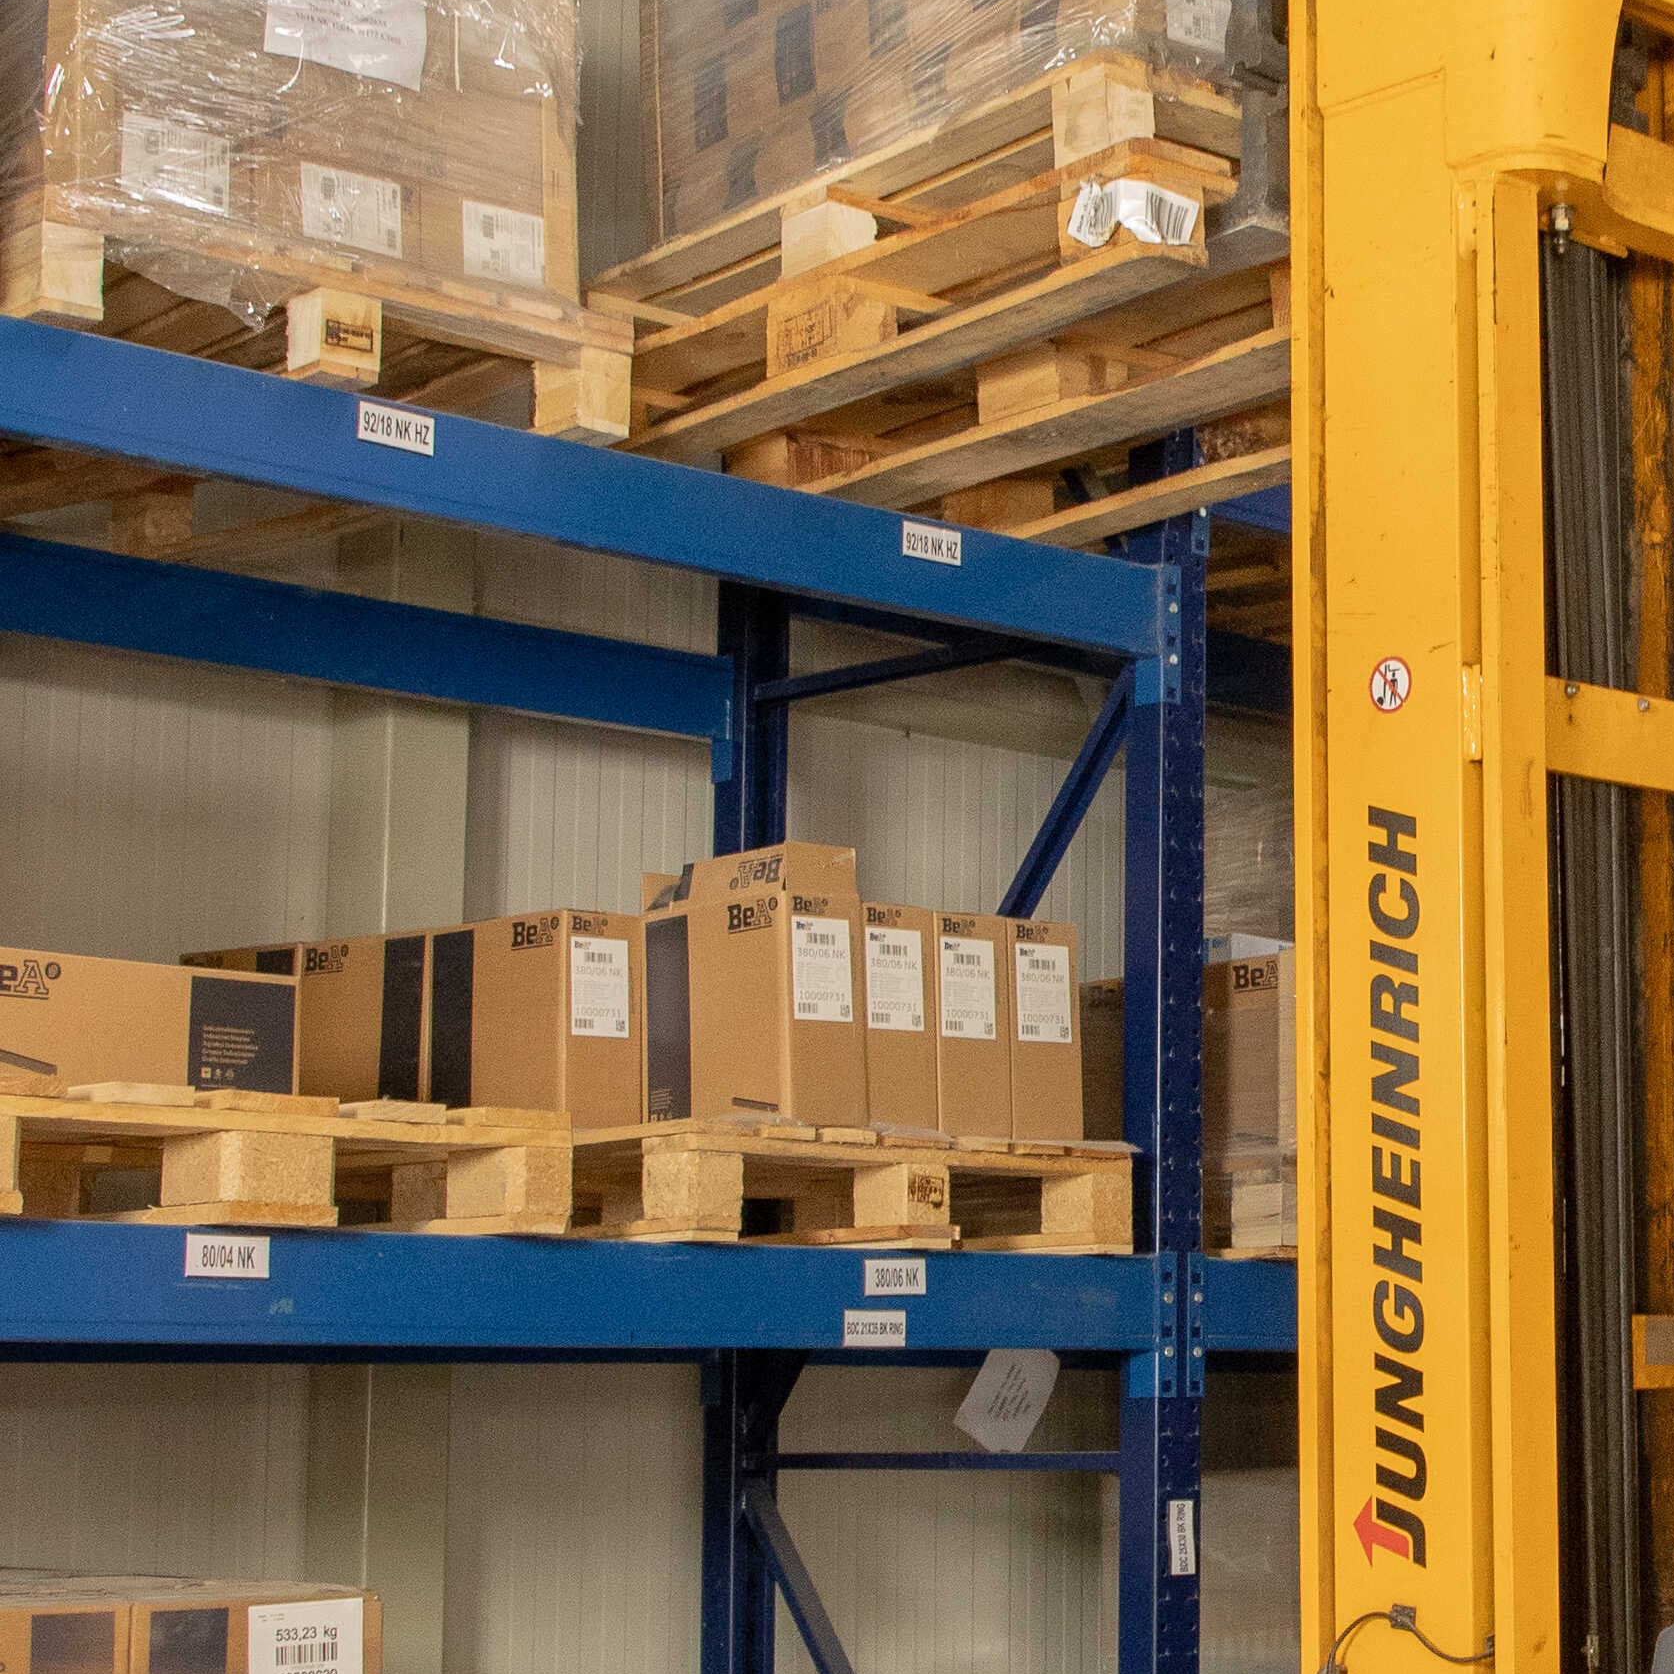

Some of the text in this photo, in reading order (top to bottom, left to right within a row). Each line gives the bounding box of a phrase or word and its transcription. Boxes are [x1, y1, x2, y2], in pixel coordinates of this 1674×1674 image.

[363, 410, 431, 446] 92/18 NK HZ
[905, 530, 959, 560] 92/18 NK HZ
[1367, 804, 1428, 1569] JUNGHEINRICH
[201, 1244, 256, 1269] 80/04 NK
[875, 1267, 919, 1288] 380/06 NK
[275, 1625, 338, 1642] 533,23 kg
